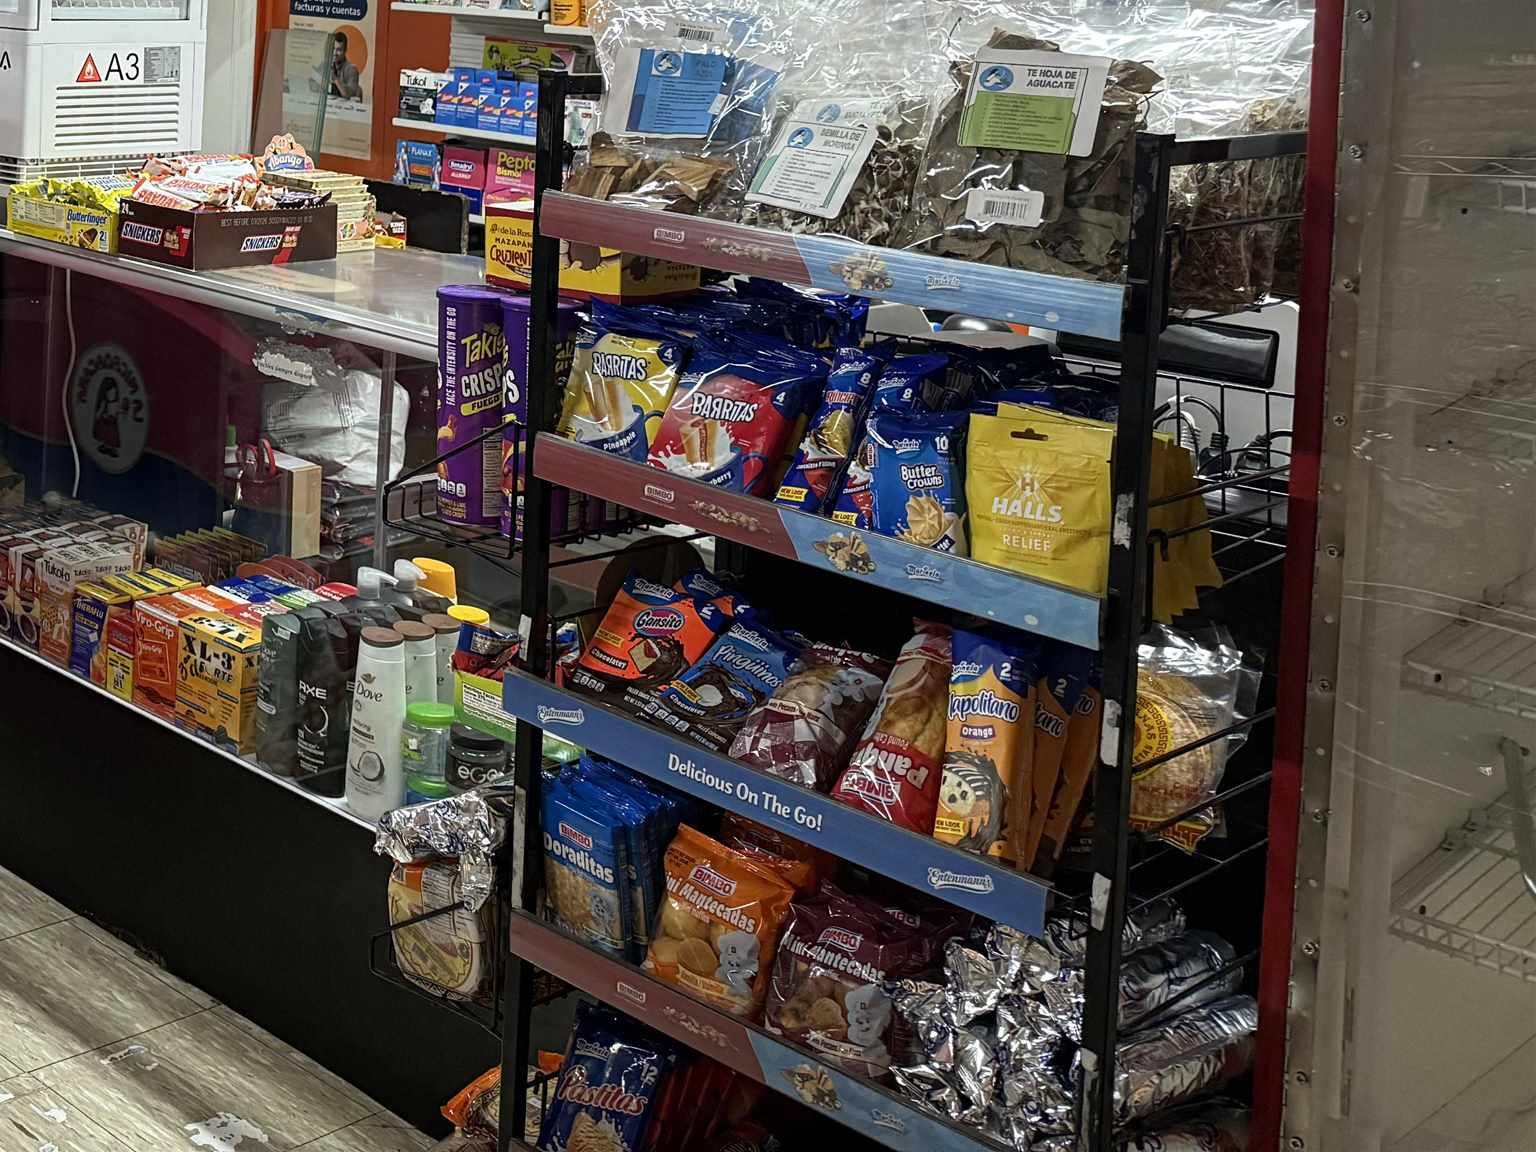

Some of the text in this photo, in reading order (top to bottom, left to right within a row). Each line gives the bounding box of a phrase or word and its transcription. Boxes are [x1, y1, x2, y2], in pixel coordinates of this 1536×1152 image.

[294, 1, 324, 13] facturas
[331, 7, 361, 16] cuentas
[105, 53, 140, 81] A3
[1027, 69, 1078, 80] TE HOJA DE
[406, 75, 427, 86] Tukol
[1026, 79, 1075, 90] AGUACATE
[67, 208, 108, 225] Butterfinger
[122, 223, 162, 244] SNICKERS
[517, 229, 532, 237] Ros
[655, 230, 684, 242] BIMBO
[243, 237, 281, 250] SNICKERS
[490, 245, 532, 267] CRUJIENT
[446, 307, 456, 406] FACE THE INTENSITY ON THE GO
[461, 332, 505, 368] Takis
[664, 348, 673, 361] 4
[461, 364, 504, 397] CRISP
[861, 373, 871, 384] 8
[776, 391, 785, 404] 4
[903, 388, 912, 399] 8
[472, 395, 501, 411] FUEGO
[603, 431, 637, 452] Pineapple
[935, 436, 948, 450] 10
[901, 465, 936, 480] Butter
[907, 475, 943, 489] Crowns
[646, 486, 675, 501] BIMBO
[992, 496, 1062, 523] HALLS
[1003, 534, 1051, 551] RELIEF
[135, 610, 175, 639] Viro-Grip
[635, 609, 683, 629] Gansito
[591, 649, 627, 669] Chocolatey
[713, 643, 782, 688] Pingüinos
[1001, 663, 1012, 678] 2
[300, 680, 328, 698] AXE
[356, 678, 383, 703] Dove
[670, 694, 706, 716] Chocolatey
[962, 727, 994, 738] Orange
[668, 752, 824, 832] Delicious On The Go!
[693, 867, 733, 894] BIMBO
[929, 867, 994, 892] Entenmann's
[682, 883, 756, 933] Mantecadas
[823, 929, 860, 950] BIMBO
[619, 983, 646, 1002] BIMBO
